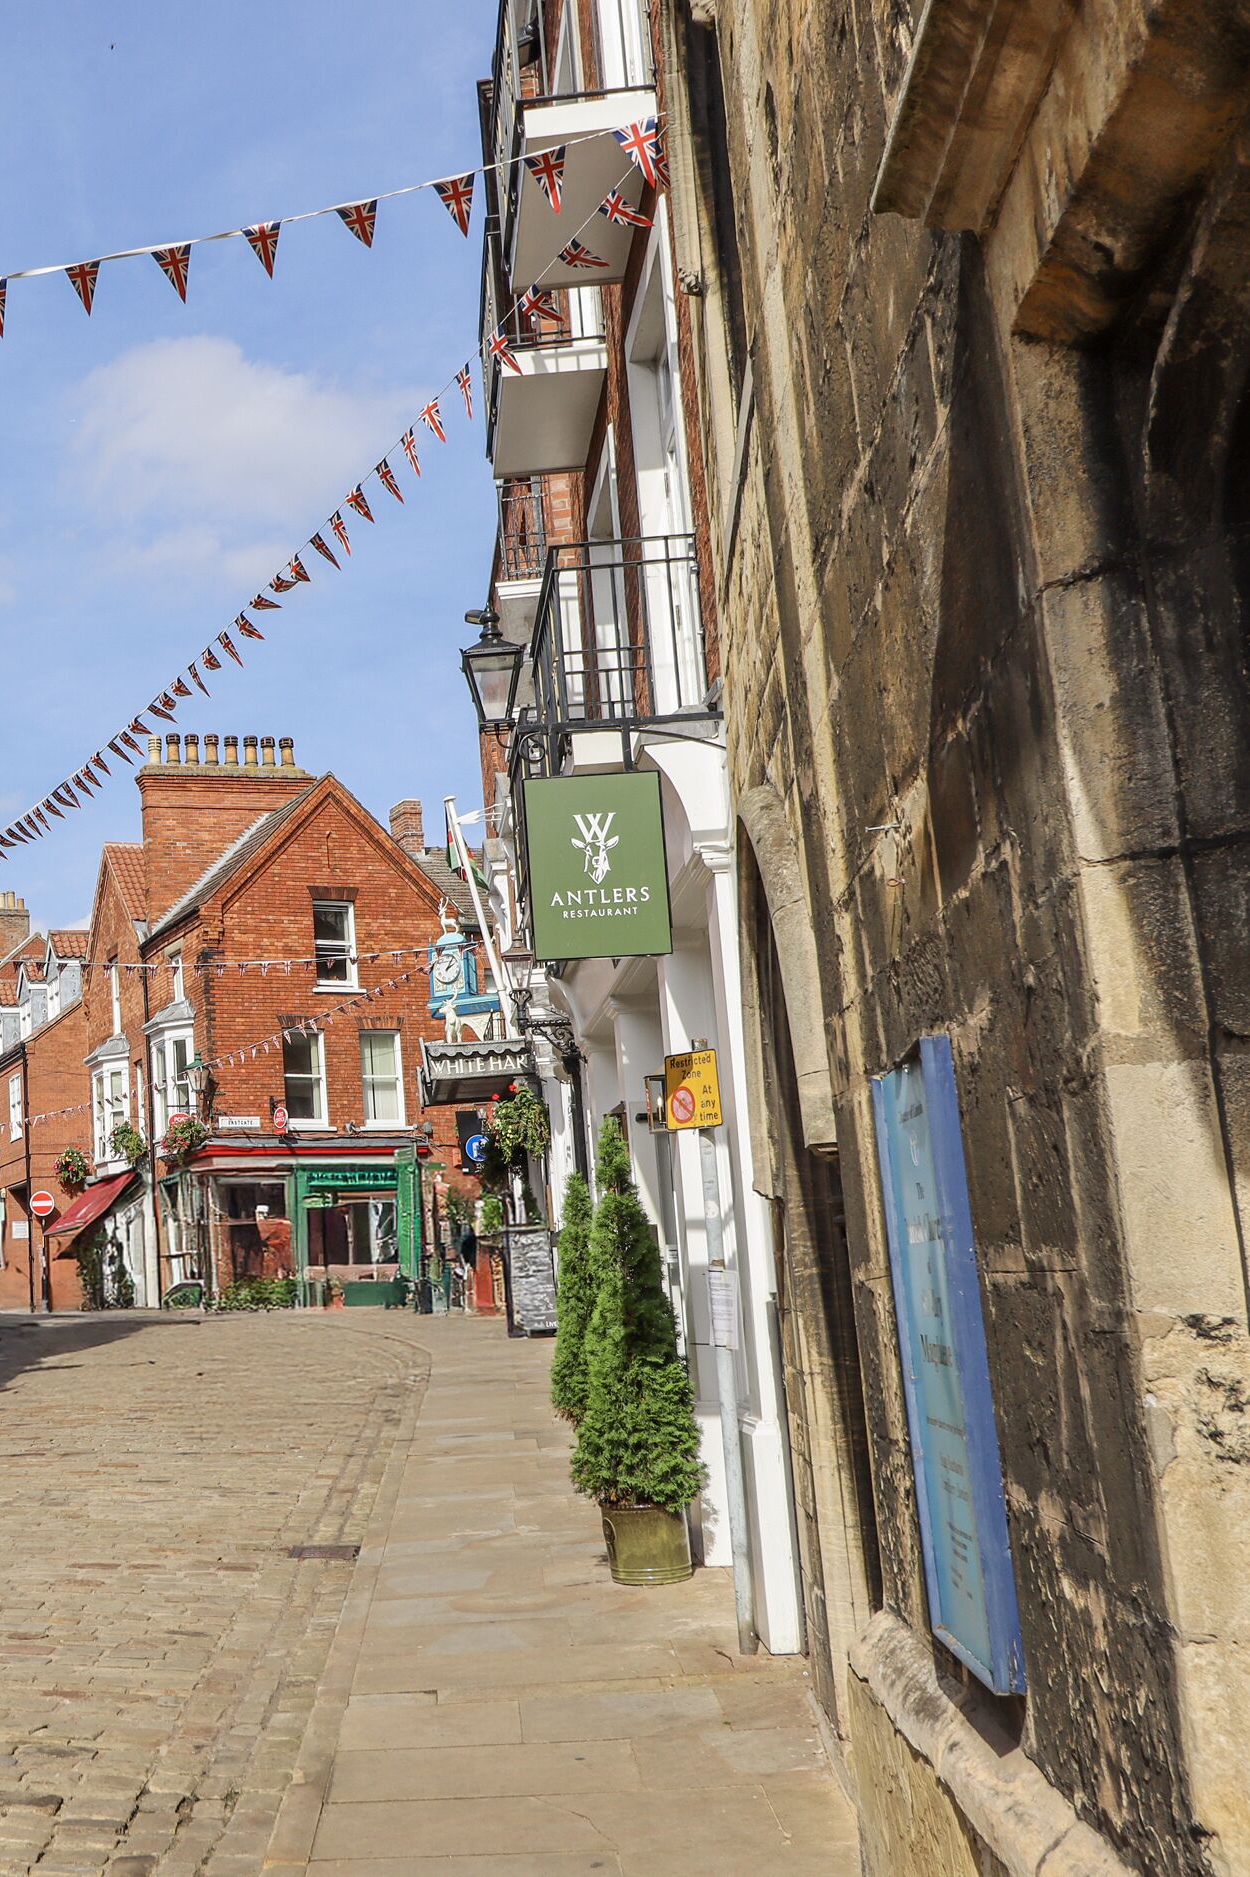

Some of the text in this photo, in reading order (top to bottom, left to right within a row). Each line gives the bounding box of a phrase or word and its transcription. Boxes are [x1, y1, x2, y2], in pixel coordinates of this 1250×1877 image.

[550, 886, 650, 907] ANTLERS
[563, 907, 638, 919] RESTAURANT
[430, 1056, 486, 1075] WHITE
[670, 1053, 711, 1069] Restricted
[681, 1069, 702, 1080] Zone
[702, 1084, 712, 1095] At
[701, 1099, 716, 1108] any
[699, 1111, 719, 1121] time
